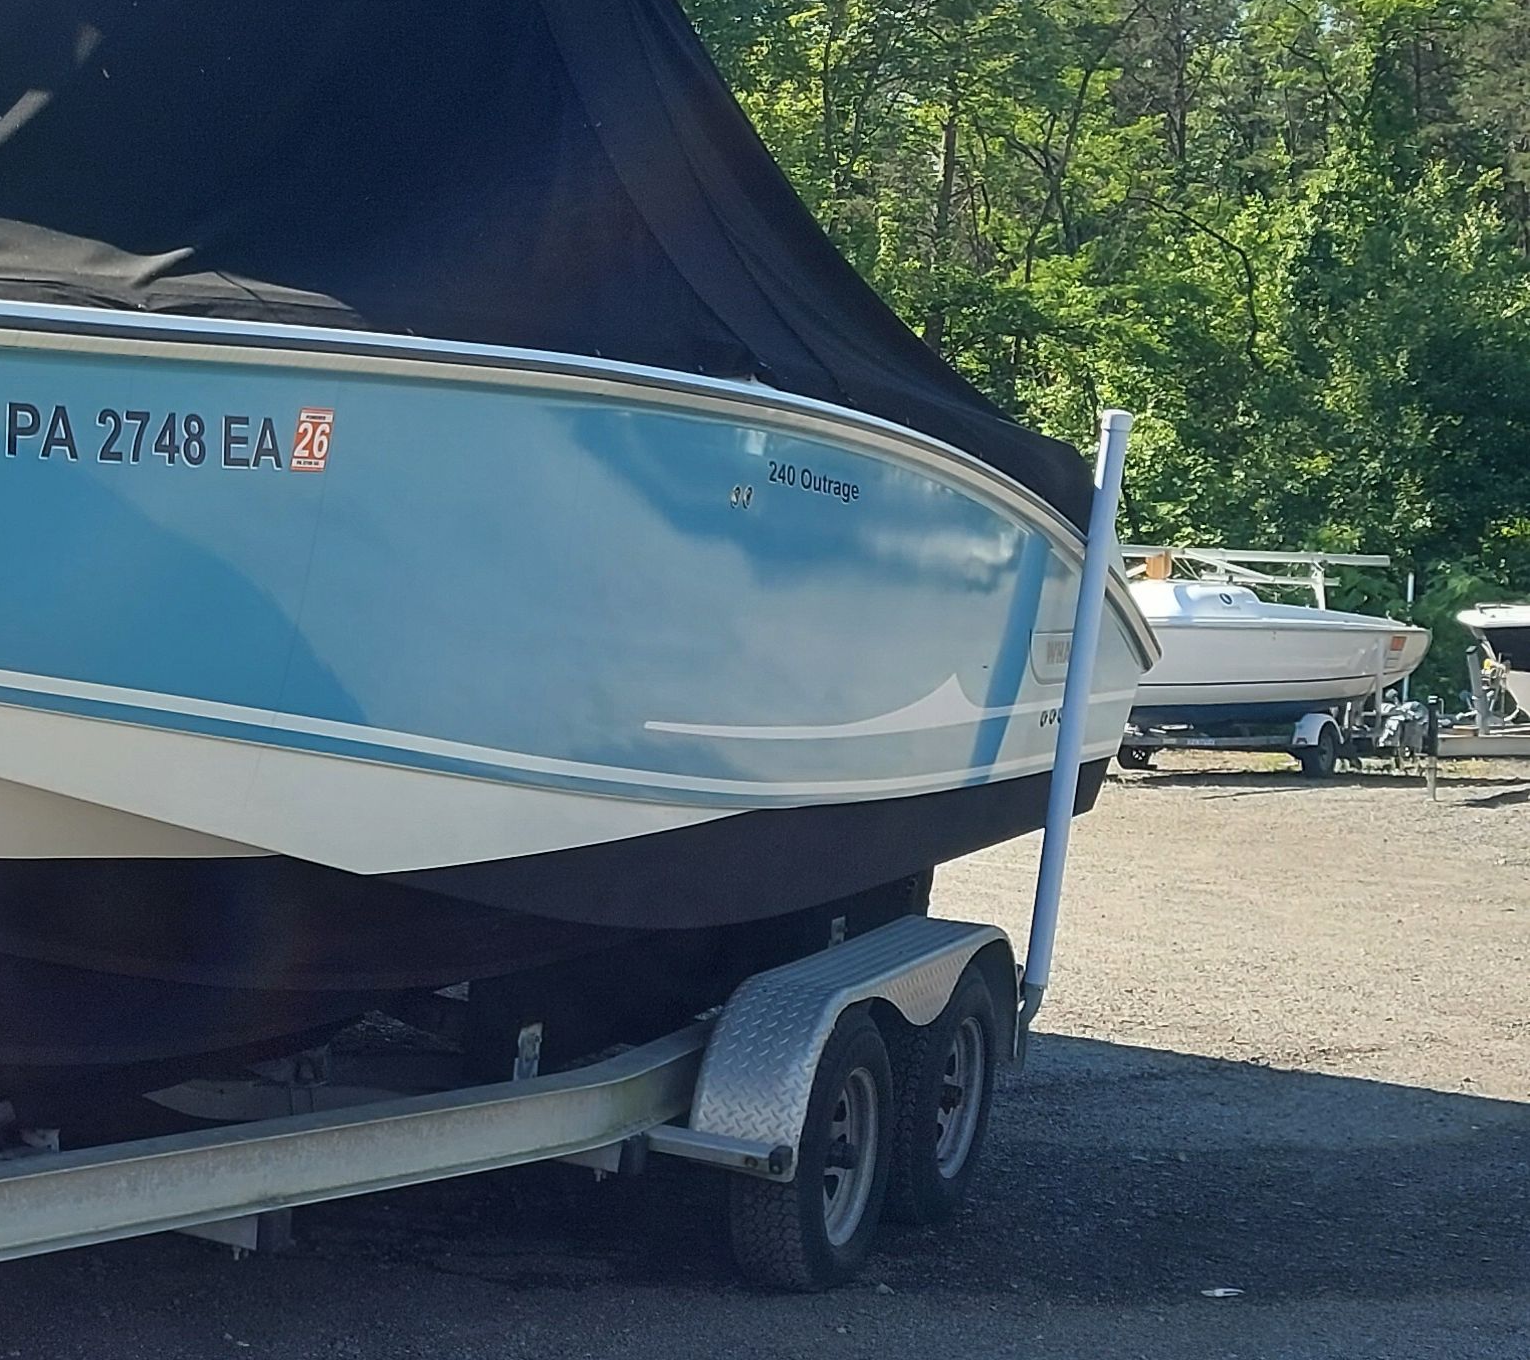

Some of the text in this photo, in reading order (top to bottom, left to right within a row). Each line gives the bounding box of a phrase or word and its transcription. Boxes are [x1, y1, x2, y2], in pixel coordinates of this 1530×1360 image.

[5, 402, 283, 470] PA 2748 EA
[293, 422, 330, 458] 26
[768, 460, 860, 503] 240 Outrage
